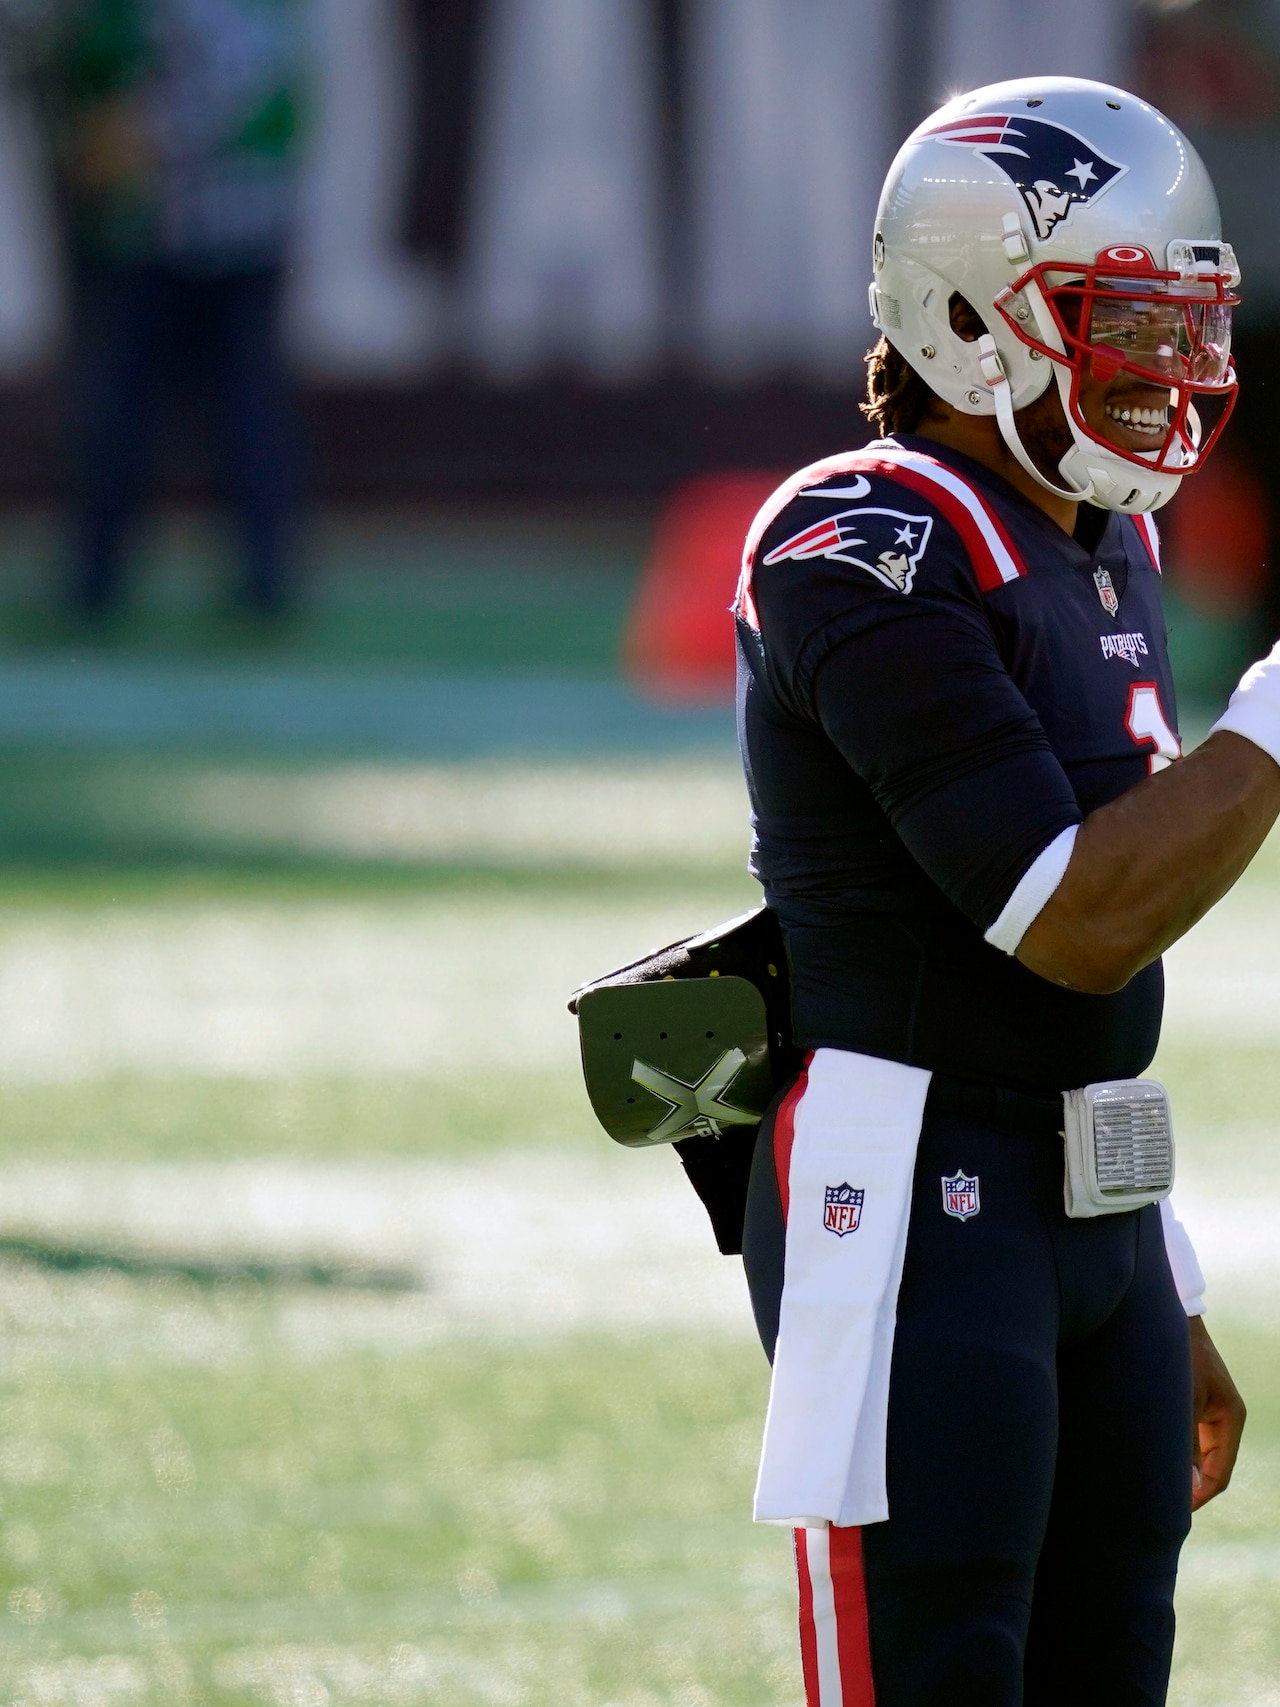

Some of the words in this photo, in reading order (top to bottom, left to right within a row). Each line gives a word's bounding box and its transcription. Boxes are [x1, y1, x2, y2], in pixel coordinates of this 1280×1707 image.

[1100, 632, 1148, 660] PATRIOTS
[947, 1193, 975, 1213] NFL
[825, 1204, 857, 1232] NFL
